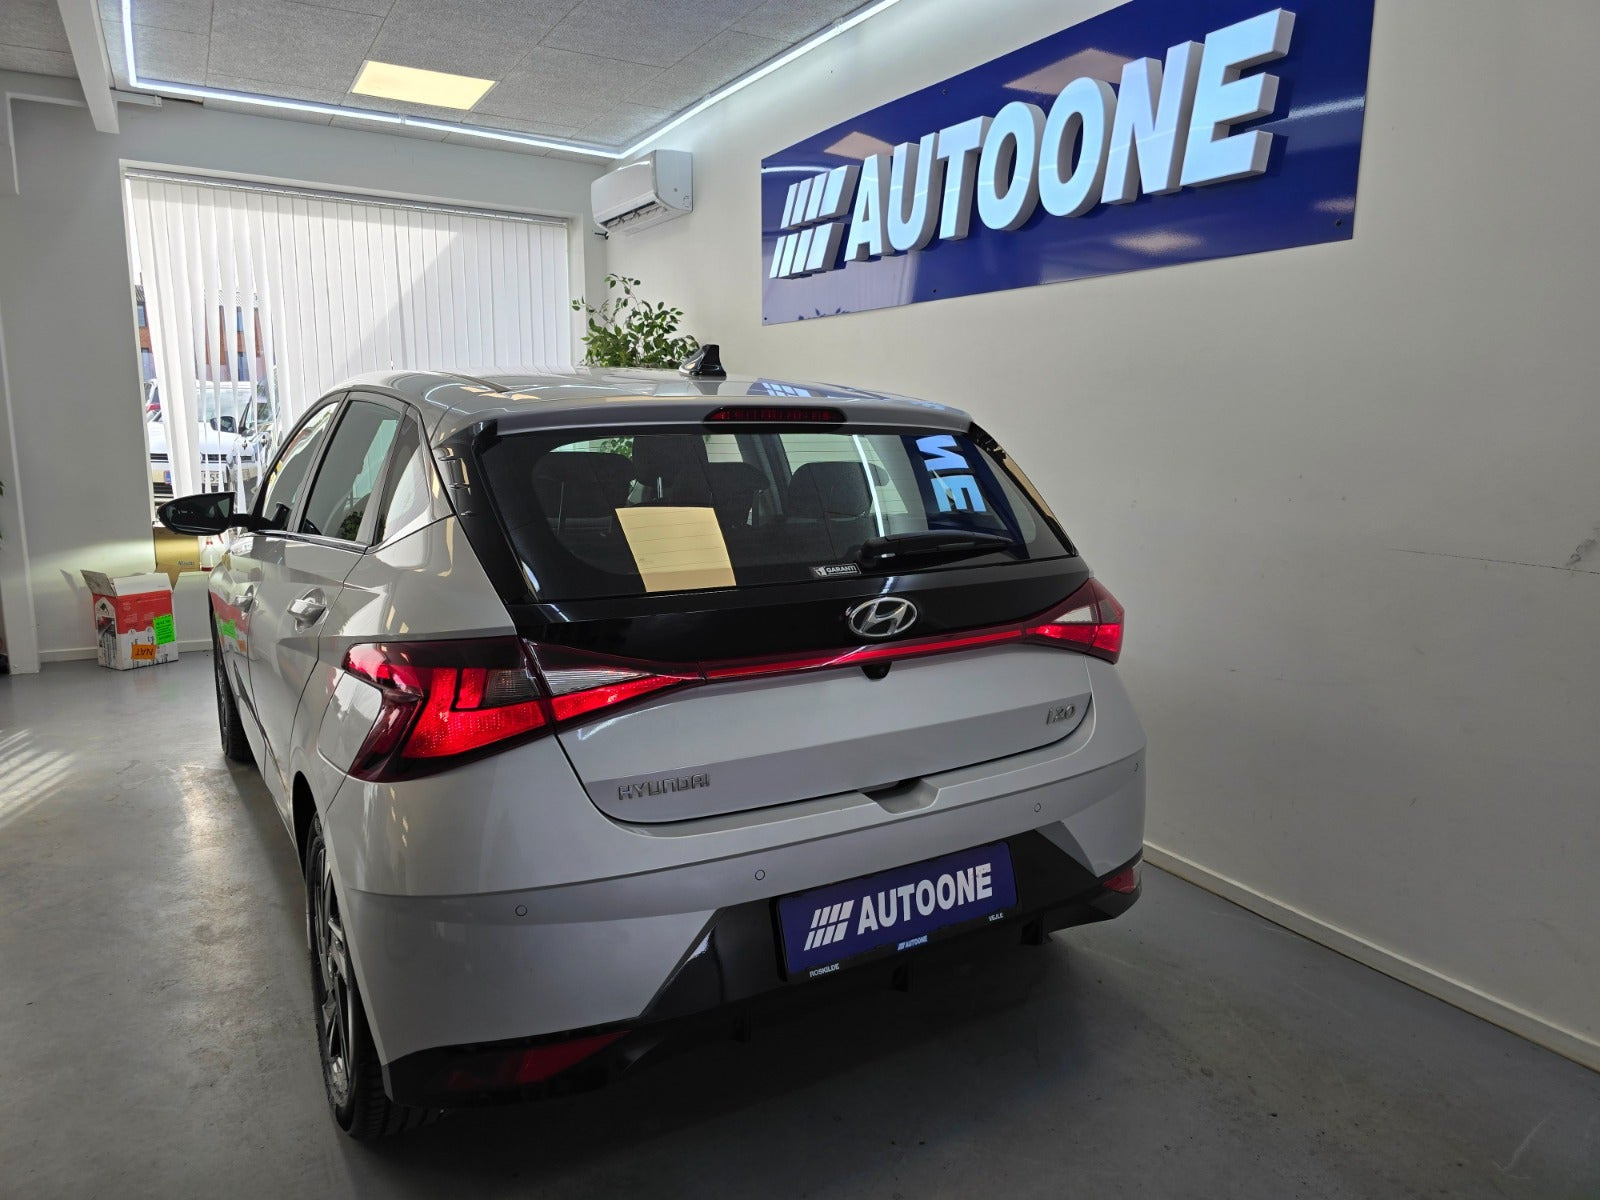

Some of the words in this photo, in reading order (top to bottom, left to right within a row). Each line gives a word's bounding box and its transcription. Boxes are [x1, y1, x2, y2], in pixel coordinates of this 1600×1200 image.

[844, 8, 1296, 262] AUTOONE
[825, 565, 857, 573] GARANTI
[618, 773, 710, 800] HYUNDAI
[857, 862, 993, 935] AUTOONE
[809, 962, 840, 978] ROSKILDE
